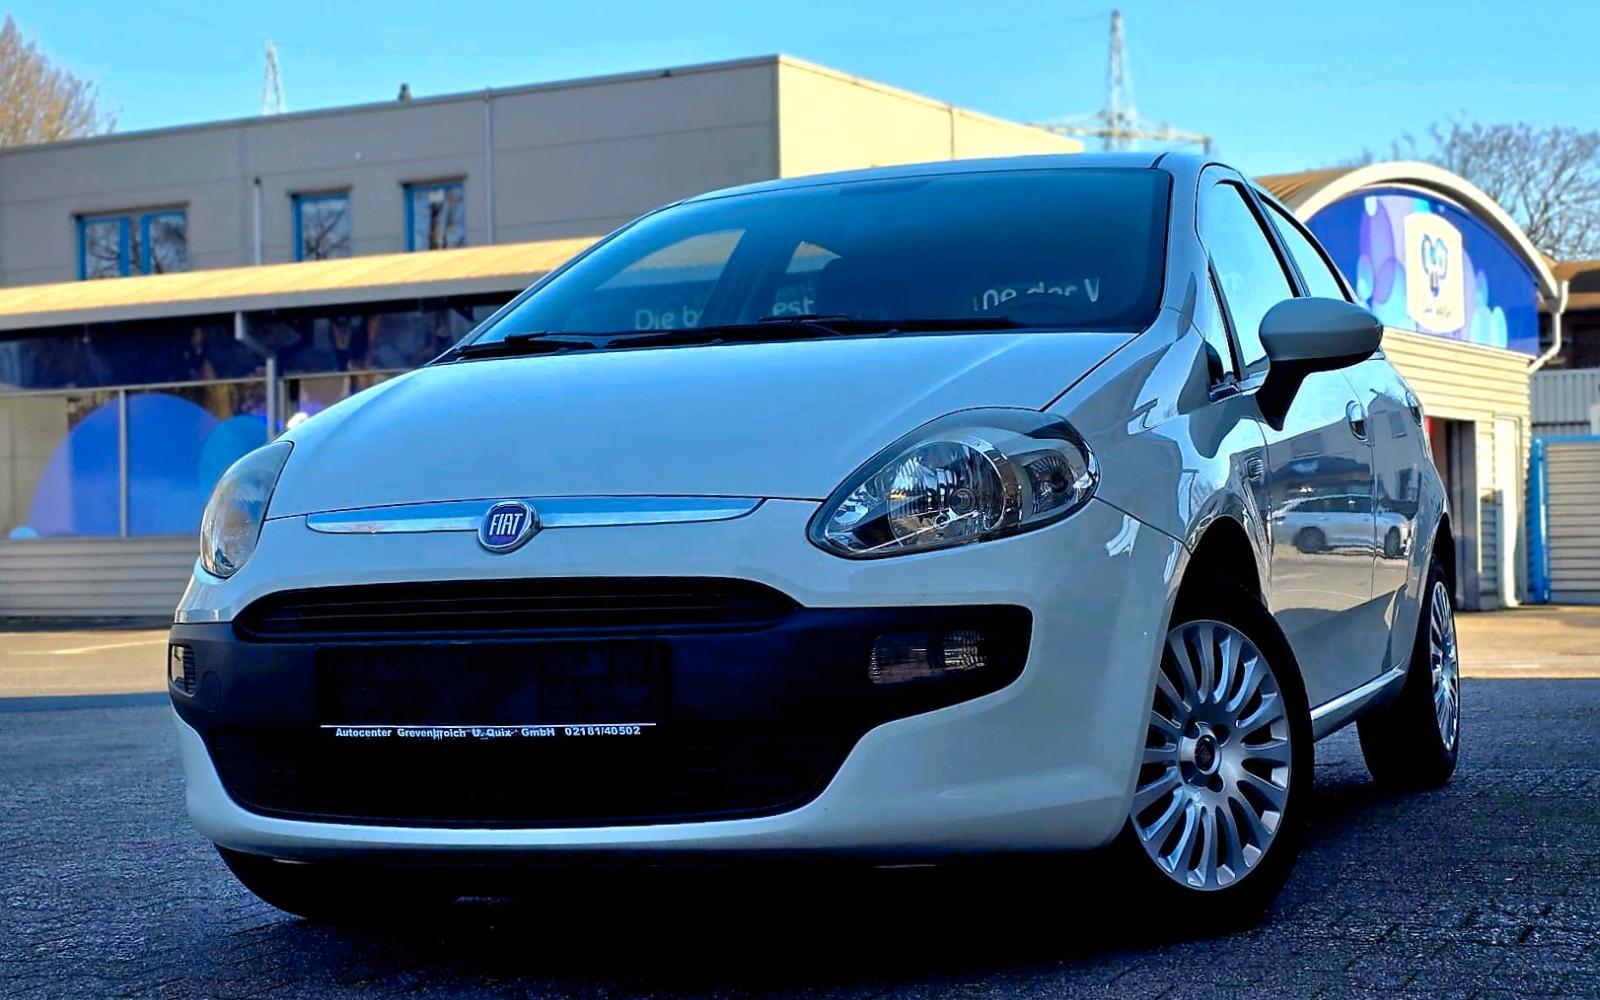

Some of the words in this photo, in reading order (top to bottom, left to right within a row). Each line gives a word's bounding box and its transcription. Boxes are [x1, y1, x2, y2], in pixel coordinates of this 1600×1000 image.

[635, 308, 675, 331] Die
[489, 513, 524, 536] FIAT
[335, 728, 393, 737] Autocenter
[521, 727, 556, 737] GmbH
[564, 726, 641, 737] 02181/40502
